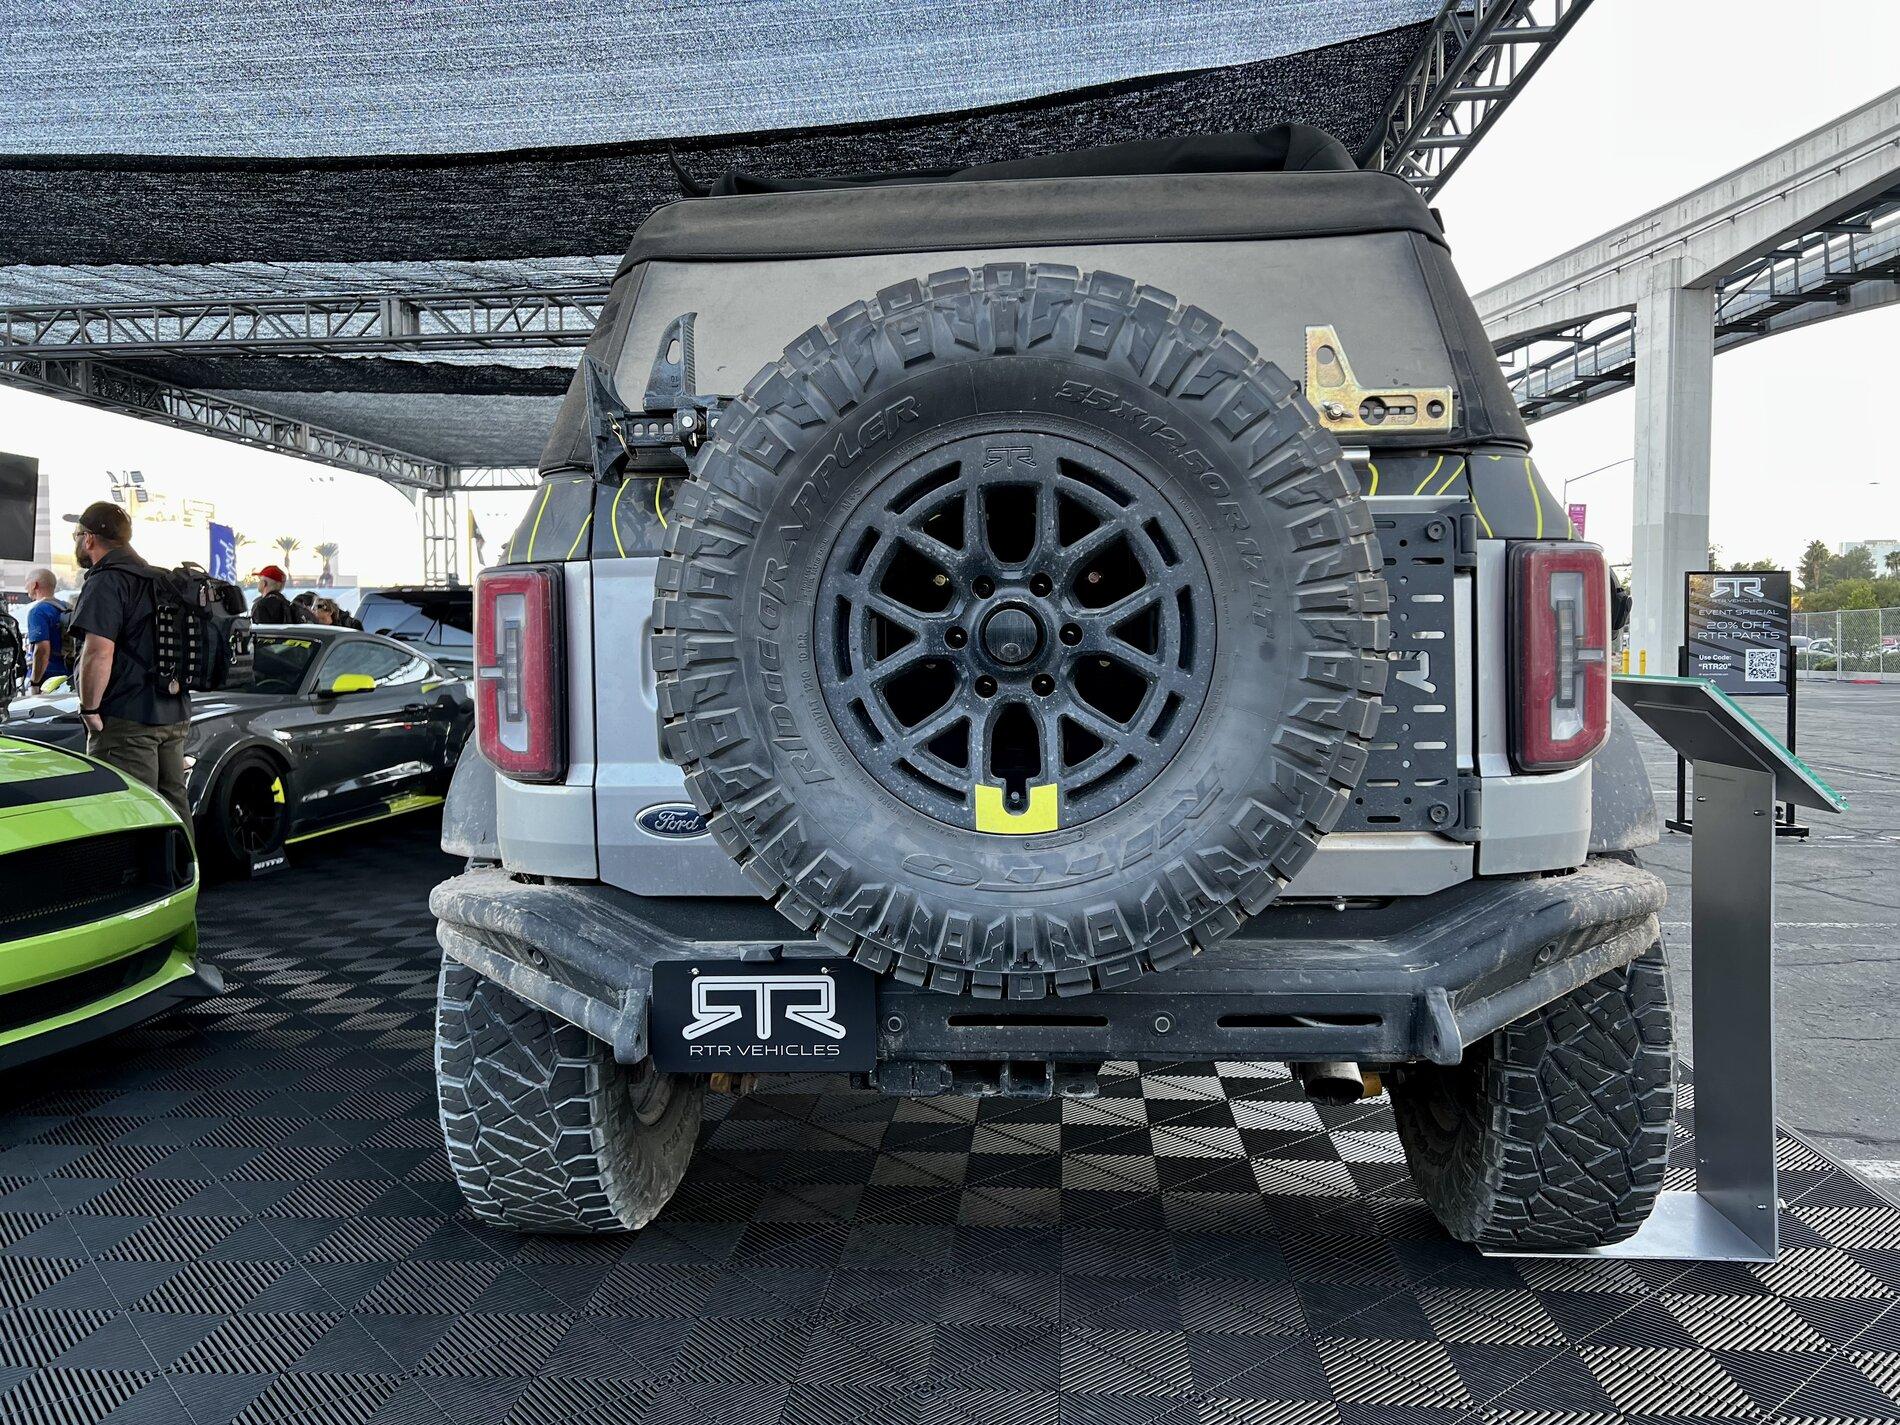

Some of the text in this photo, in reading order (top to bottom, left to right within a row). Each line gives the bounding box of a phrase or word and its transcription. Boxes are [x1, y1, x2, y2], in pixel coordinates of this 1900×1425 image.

[982, 445, 1037, 469] RTR
[756, 394, 923, 785] RIDGE GRAPPLER
[1710, 577, 1765, 598] RTR
[1697, 631, 1780, 640] RTR PARTS
[1706, 621, 1772, 630] 20% OFF
[655, 810, 700, 831] Ford
[681, 975, 847, 1040] RTR
[689, 1044, 840, 1056] RTR VEHICLES
